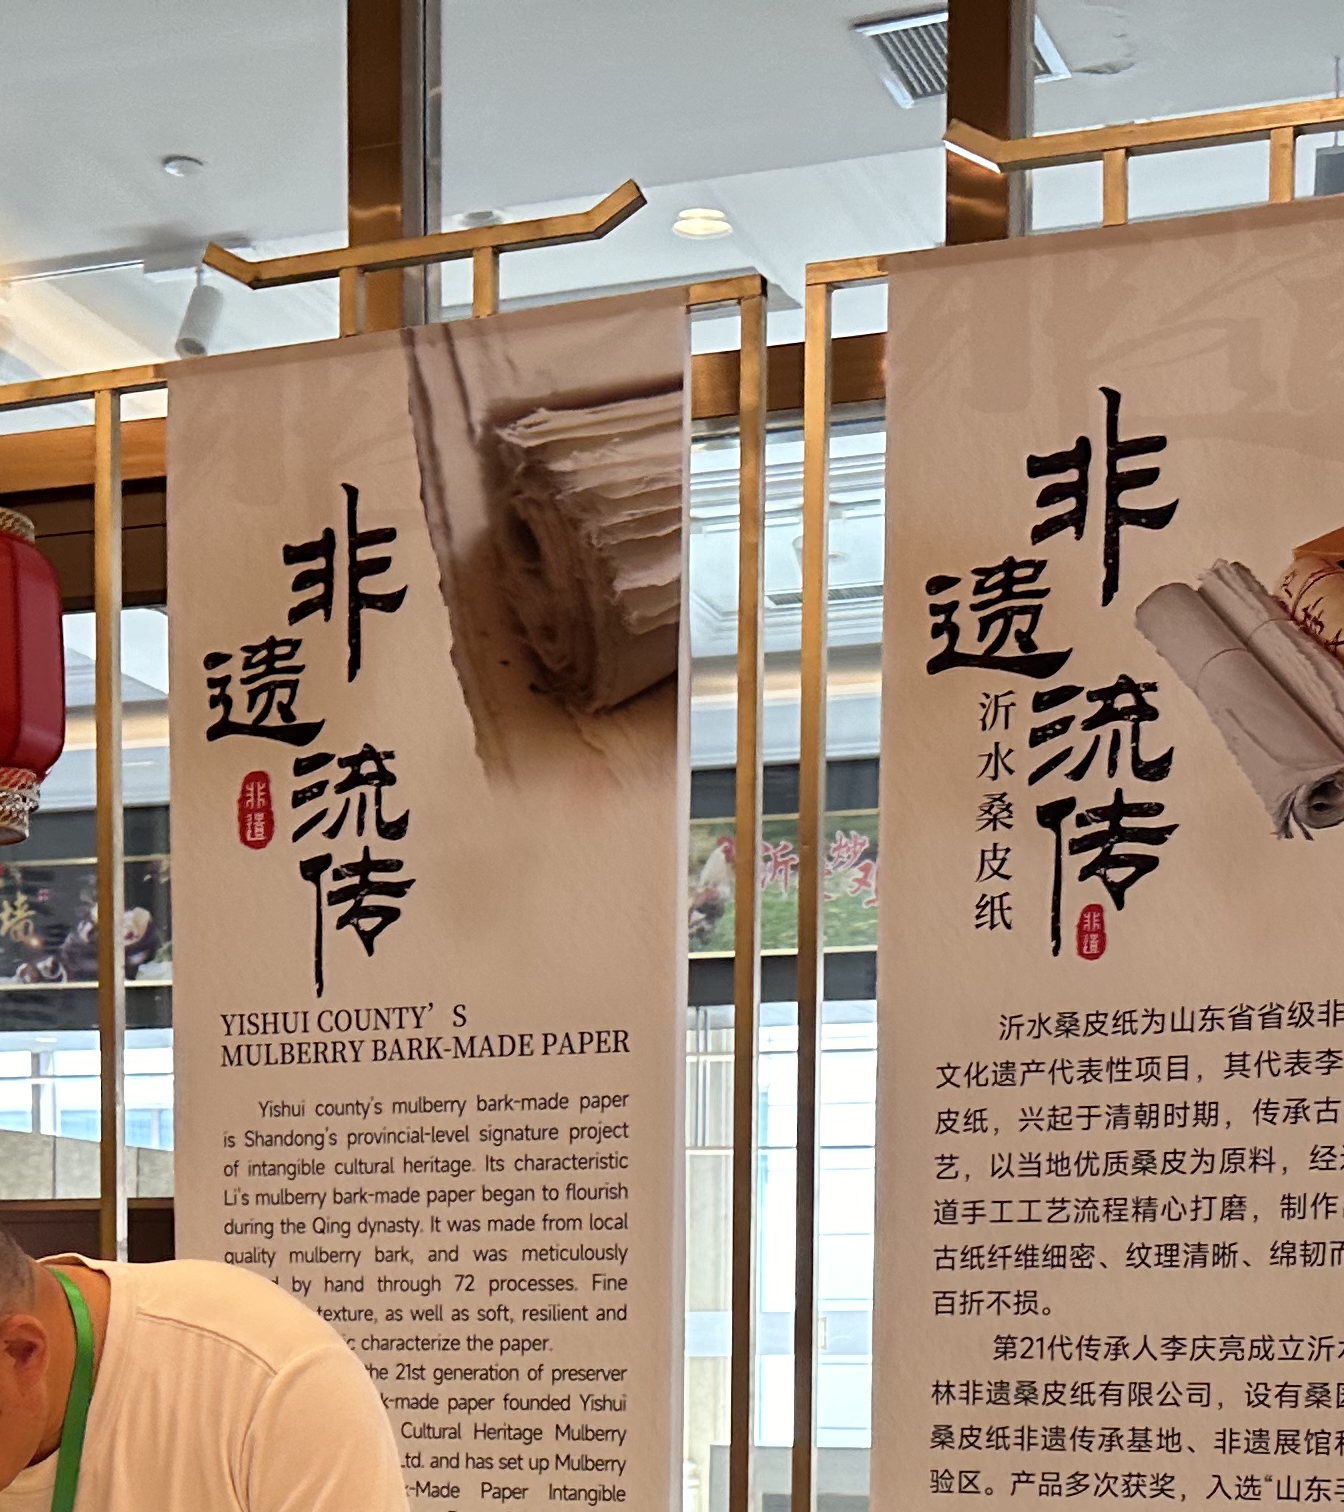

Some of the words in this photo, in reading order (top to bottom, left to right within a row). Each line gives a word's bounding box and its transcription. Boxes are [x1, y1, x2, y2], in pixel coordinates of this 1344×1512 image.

[973, 690, 1017, 931] 沂水桑皮纸
[219, 1010, 310, 1037] YISHUI
[220, 1039, 366, 1068] MULBERRY
[370, 1033, 535, 1063] BARK-MADE
[540, 1029, 631, 1056] PAPER
[257, 1099, 306, 1119] Yishui
[391, 1095, 468, 1119] mulberry
[476, 1091, 570, 1112] bark-made
[579, 1093, 631, 1115] paper
[223, 1130, 237, 1149] is
[346, 1124, 471, 1151] provincial-level
[478, 1123, 560, 1148] signature
[568, 1120, 630, 1146] project
[223, 1159, 240, 1178] of
[247, 1157, 326, 1182] intangible
[333, 1156, 395, 1176] cultural
[485, 1153, 506, 1173] Its
[513, 1150, 629, 1172] characteristic
[255, 1187, 328, 1211] mulberry
[332, 1185, 421, 1205] bark-made
[425, 1188, 477, 1209] paper
[481, 1183, 536, 1208] began
[541, 1184, 560, 1202] to
[565, 1181, 629, 1201] flourish
[223, 1217, 275, 1240] during
[279, 1217, 307, 1235] the
[311, 1215, 352, 1240] Qing
[430, 1214, 442, 1234] It
[446, 1218, 482, 1233] was
[487, 1213, 536, 1233] made
[541, 1212, 583, 1232] from
[589, 1211, 629, 1231] local
[223, 1245, 277, 1269] quality
[288, 1245, 362, 1269] mulberry
[427, 1244, 460, 1263] and
[471, 1248, 509, 1263] was
[521, 1242, 629, 1267] meticulously
[291, 1275, 313, 1298] by
[323, 1274, 365, 1293] hand
[376, 1273, 442, 1298] through
[453, 1273, 476, 1293] 72
[591, 1272, 629, 1292] Fine
[384, 1307, 404, 1323] as
[409, 1303, 444, 1322] well
[450, 1307, 470, 1322] as
[521, 1302, 590, 1322] resilient
[595, 1302, 628, 1322] and
[931, 1288, 1052, 1317] 百折不损。
[360, 1332, 461, 1352] characterize
[465, 1333, 495, 1352] the
[395, 1362, 427, 1381] 21st
[432, 1362, 520, 1386] generation
[526, 1363, 545, 1382] of
[551, 1367, 629, 1387] preserver
[447, 1397, 496, 1416] paper
[502, 1392, 571, 1412] founded
[578, 1393, 628, 1413] Yishui
[400, 1421, 463, 1440] Cultural
[473, 1421, 544, 1446] Heritage
[554, 1423, 628, 1448] Mulberry
[429, 1451, 460, 1470] and
[464, 1451, 495, 1471] has
[498, 1453, 525, 1471] set
[528, 1457, 551, 1476] up
[554, 1452, 628, 1478] Mulberry
[480, 1481, 530, 1505] Paper
[548, 1482, 627, 1507] Intangible
